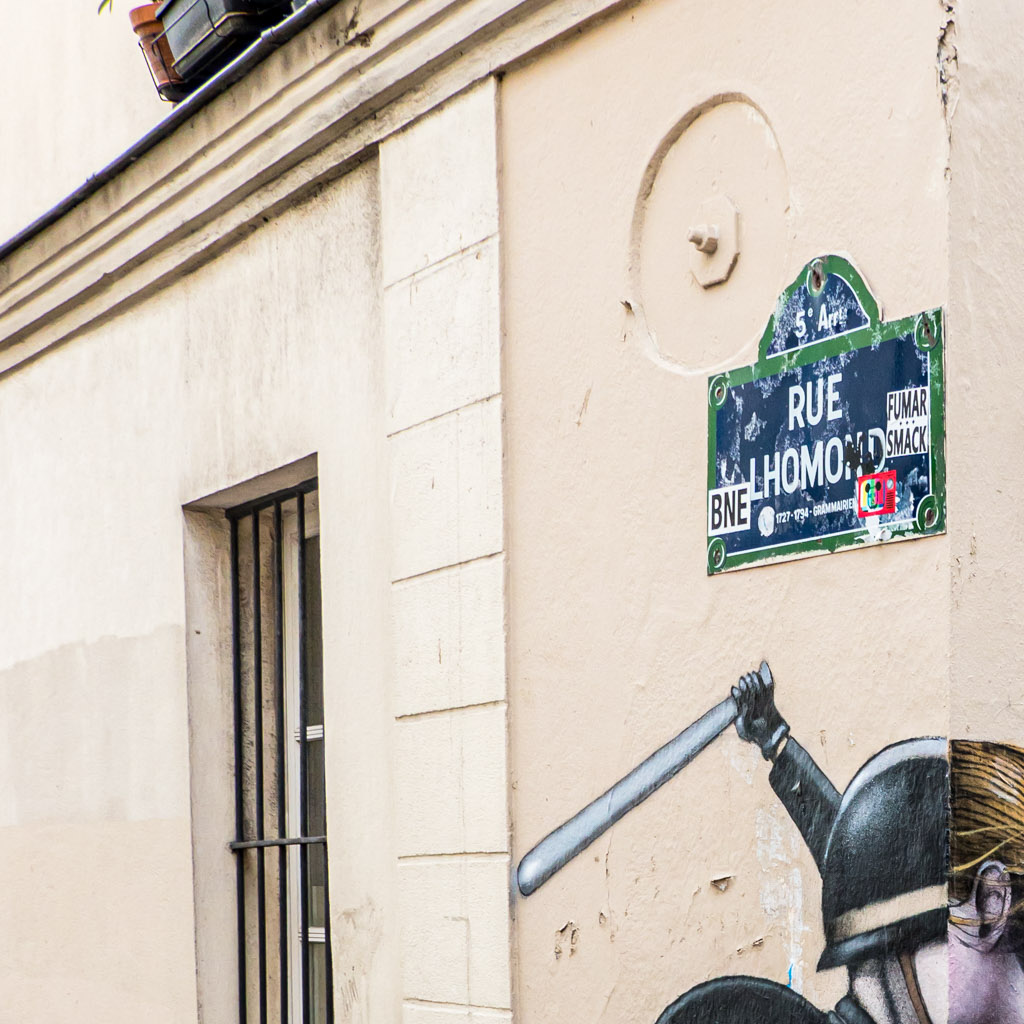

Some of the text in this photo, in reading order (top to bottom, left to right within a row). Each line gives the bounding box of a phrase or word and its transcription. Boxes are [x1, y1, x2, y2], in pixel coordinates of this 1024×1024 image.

[788, 374, 843, 430] RUE
[888, 391, 927, 420] FUMAR
[887, 426, 927, 456] SMACK
[750, 427, 886, 501] LHOMOND
[711, 487, 748, 530] BNE
